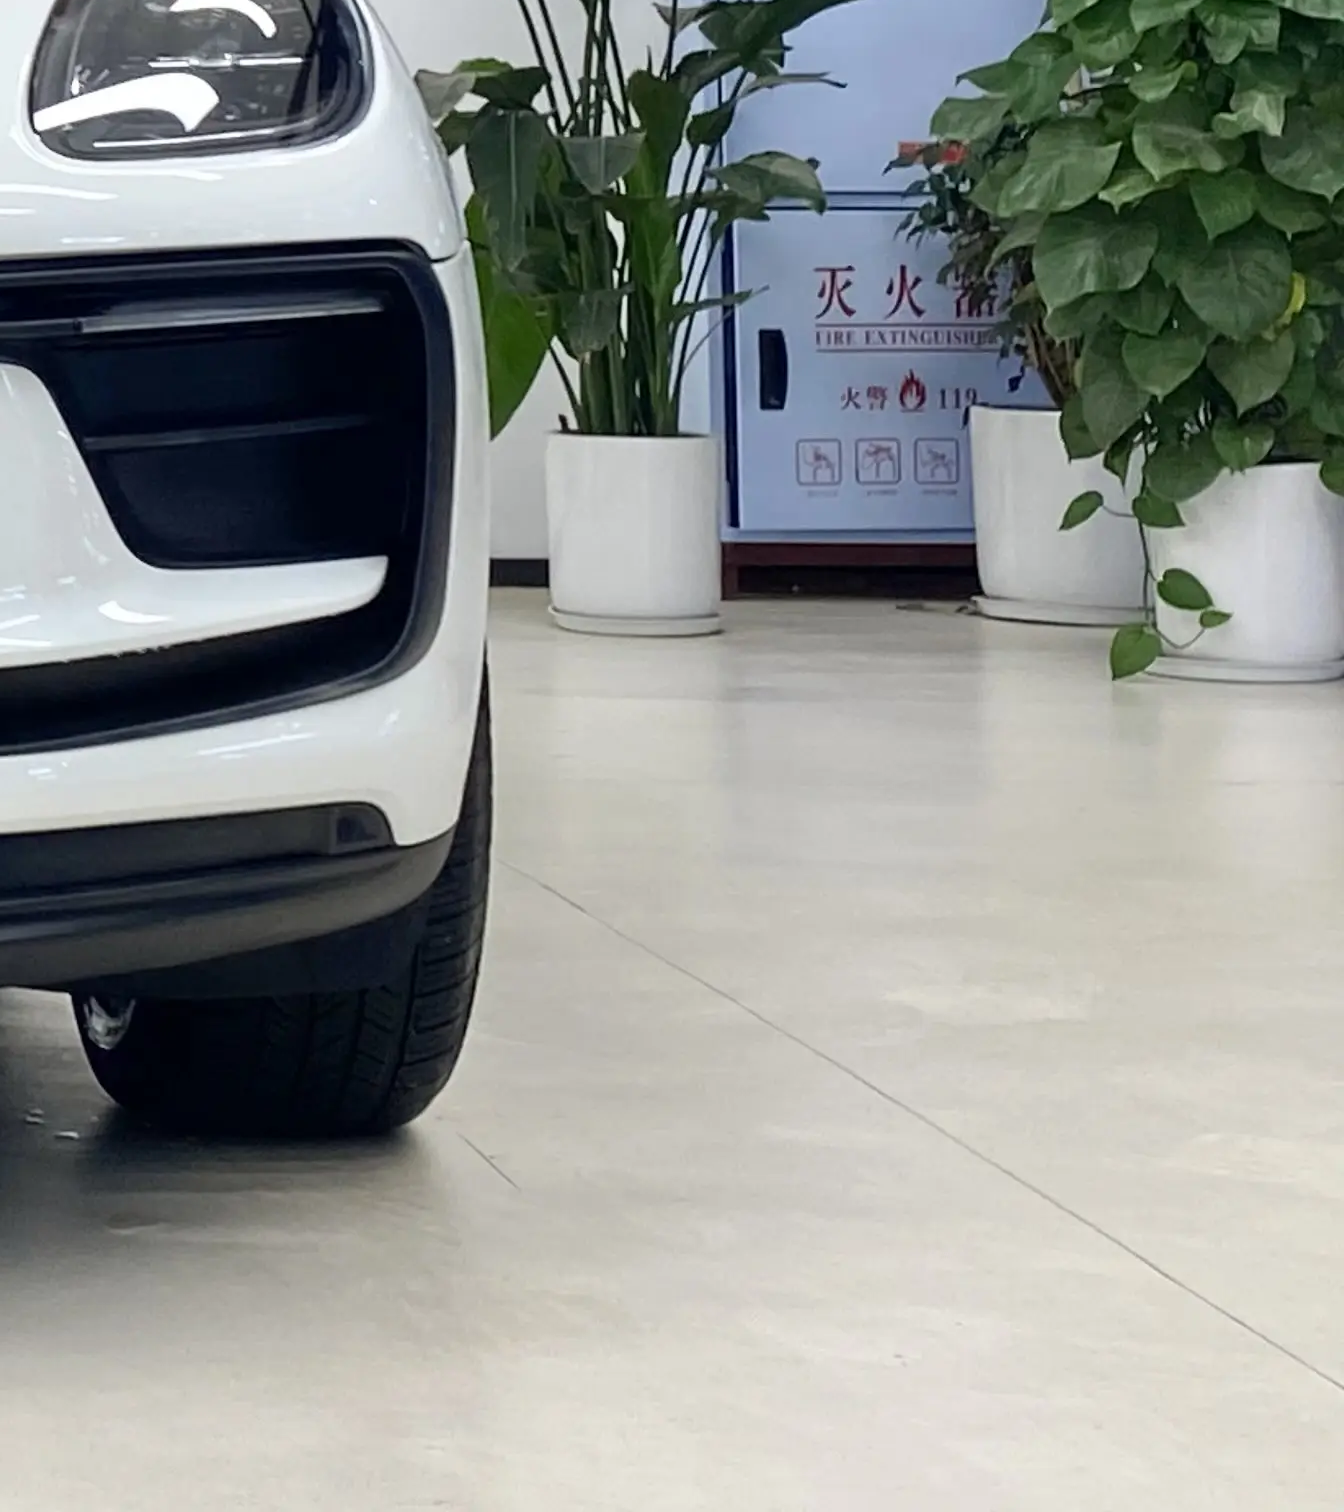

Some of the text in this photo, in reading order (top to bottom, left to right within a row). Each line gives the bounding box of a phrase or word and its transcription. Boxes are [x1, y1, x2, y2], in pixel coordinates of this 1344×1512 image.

[815, 329, 856, 346] FIRE
[841, 386, 977, 411] 火警 119
